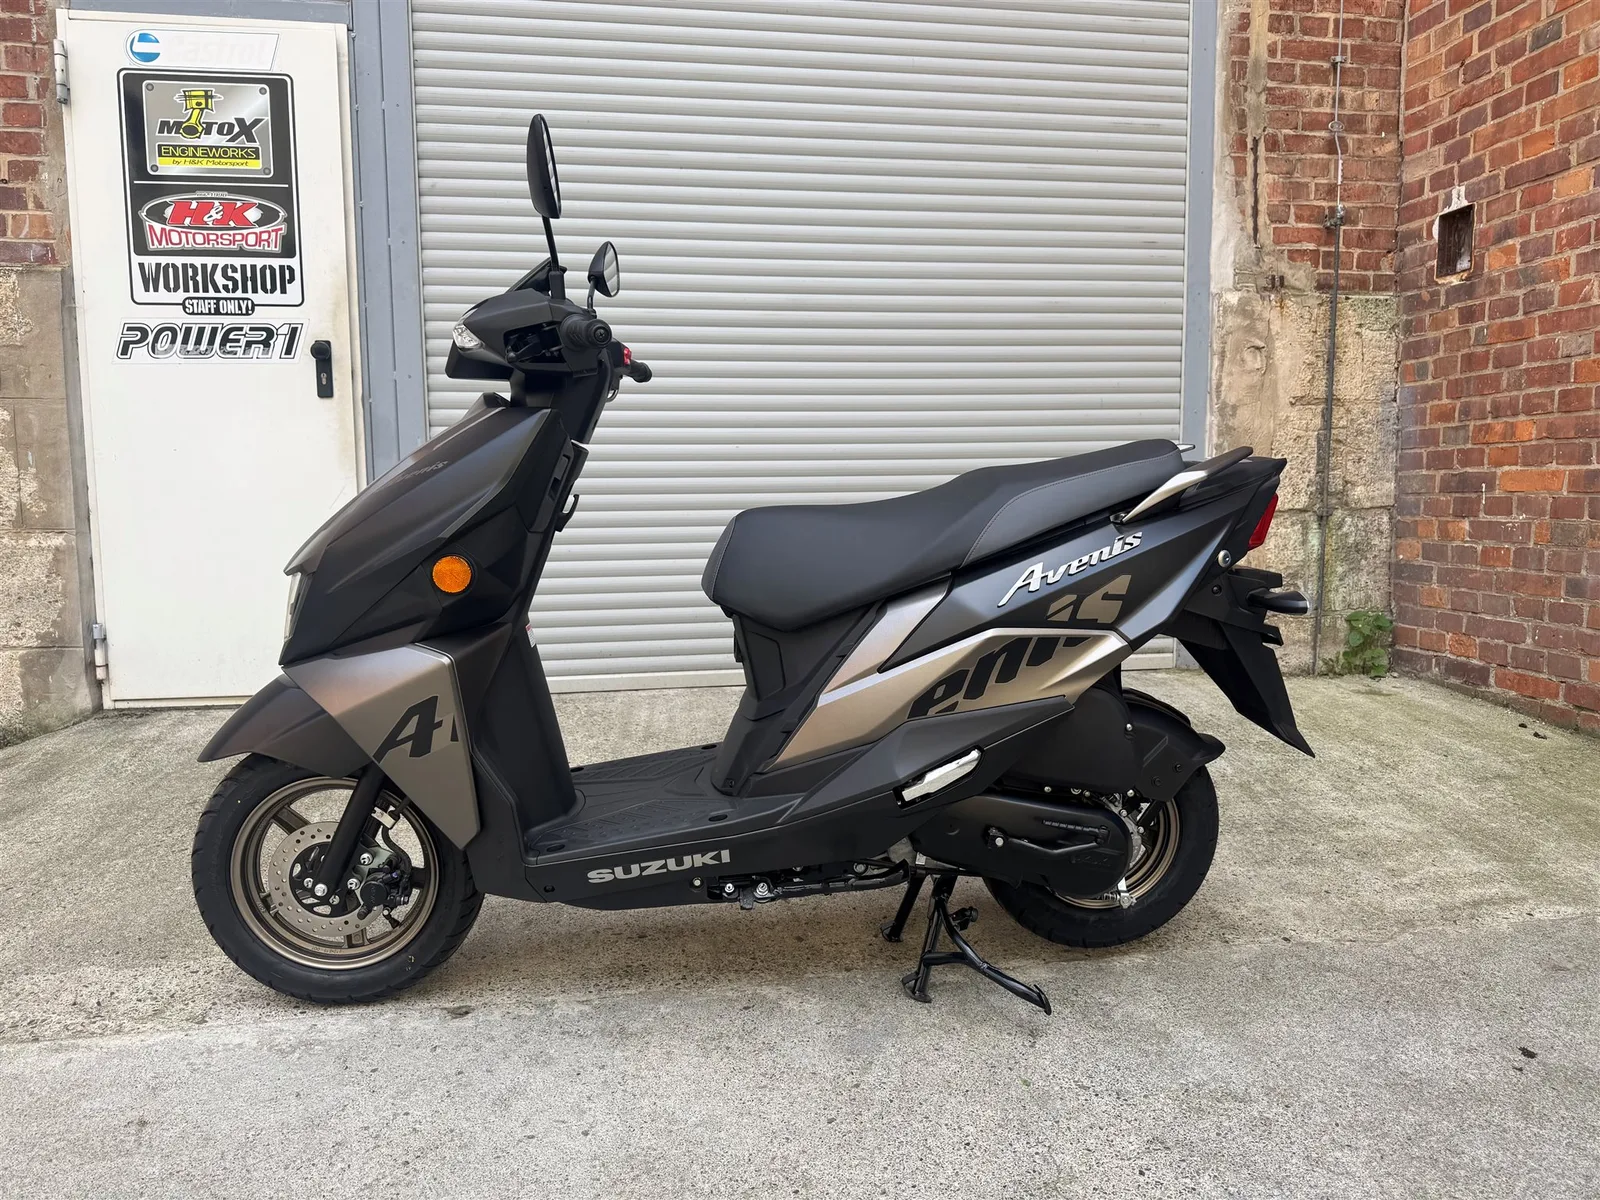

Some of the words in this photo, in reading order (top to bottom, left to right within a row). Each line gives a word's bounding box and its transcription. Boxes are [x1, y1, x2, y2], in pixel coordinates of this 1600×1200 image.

[161, 146, 256, 159] ENGINEWORKS
[206, 159, 249, 168] Motorsport
[167, 200, 258, 227] H&K
[147, 223, 285, 250] MOTORSPORT
[138, 262, 296, 295] WORKSHOP
[185, 299, 216, 314] STAFF
[219, 300, 253, 314] ONLY!
[117, 323, 303, 359] POWER1
[997, 531, 1142, 608] Avenis
[587, 849, 731, 884] SUZUKI
